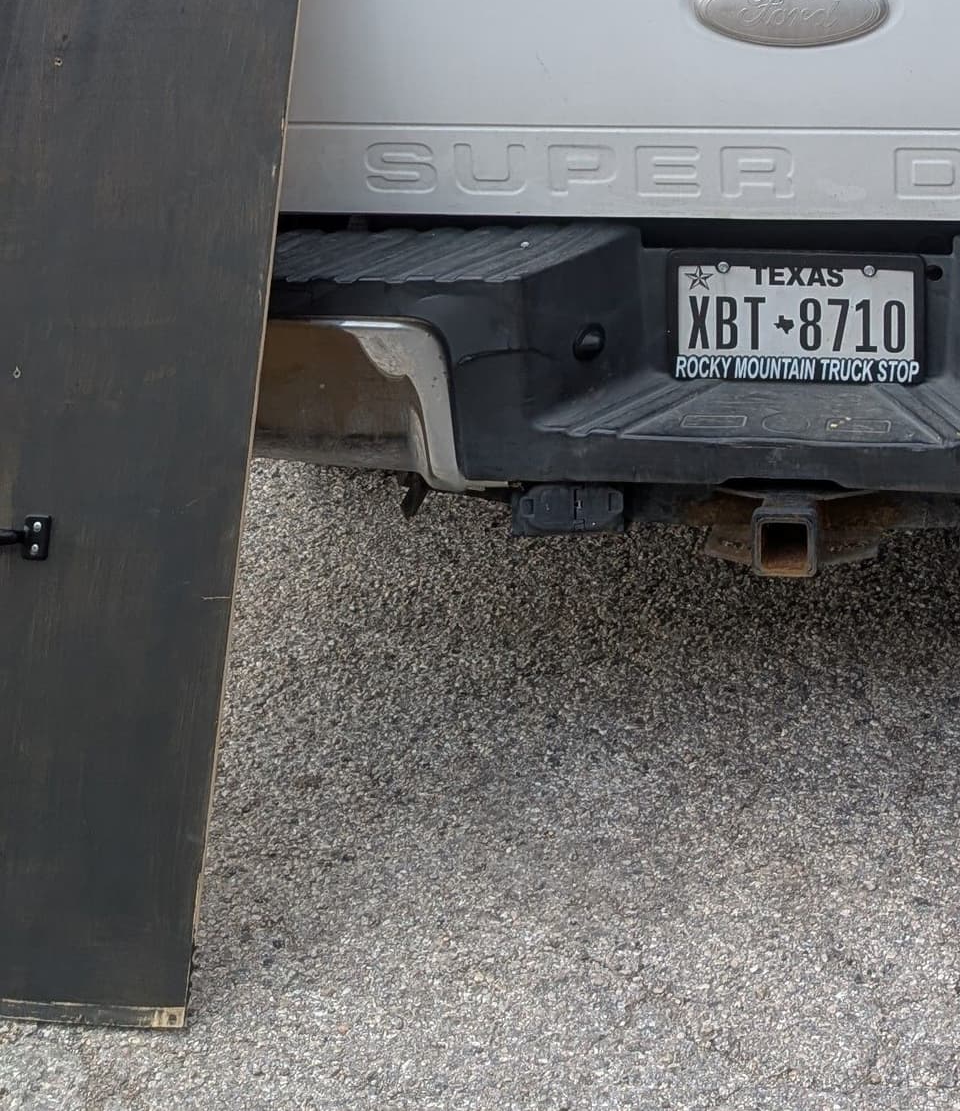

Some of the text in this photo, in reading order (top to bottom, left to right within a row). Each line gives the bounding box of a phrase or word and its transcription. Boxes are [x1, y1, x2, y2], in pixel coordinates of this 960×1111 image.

[364, 141, 796, 199] SUPER
[749, 266, 845, 287] TEXAS
[687, 295, 907, 354] XBT 8710
[674, 355, 920, 383] ROCKY MOUNTAIN TRUCK STOP
